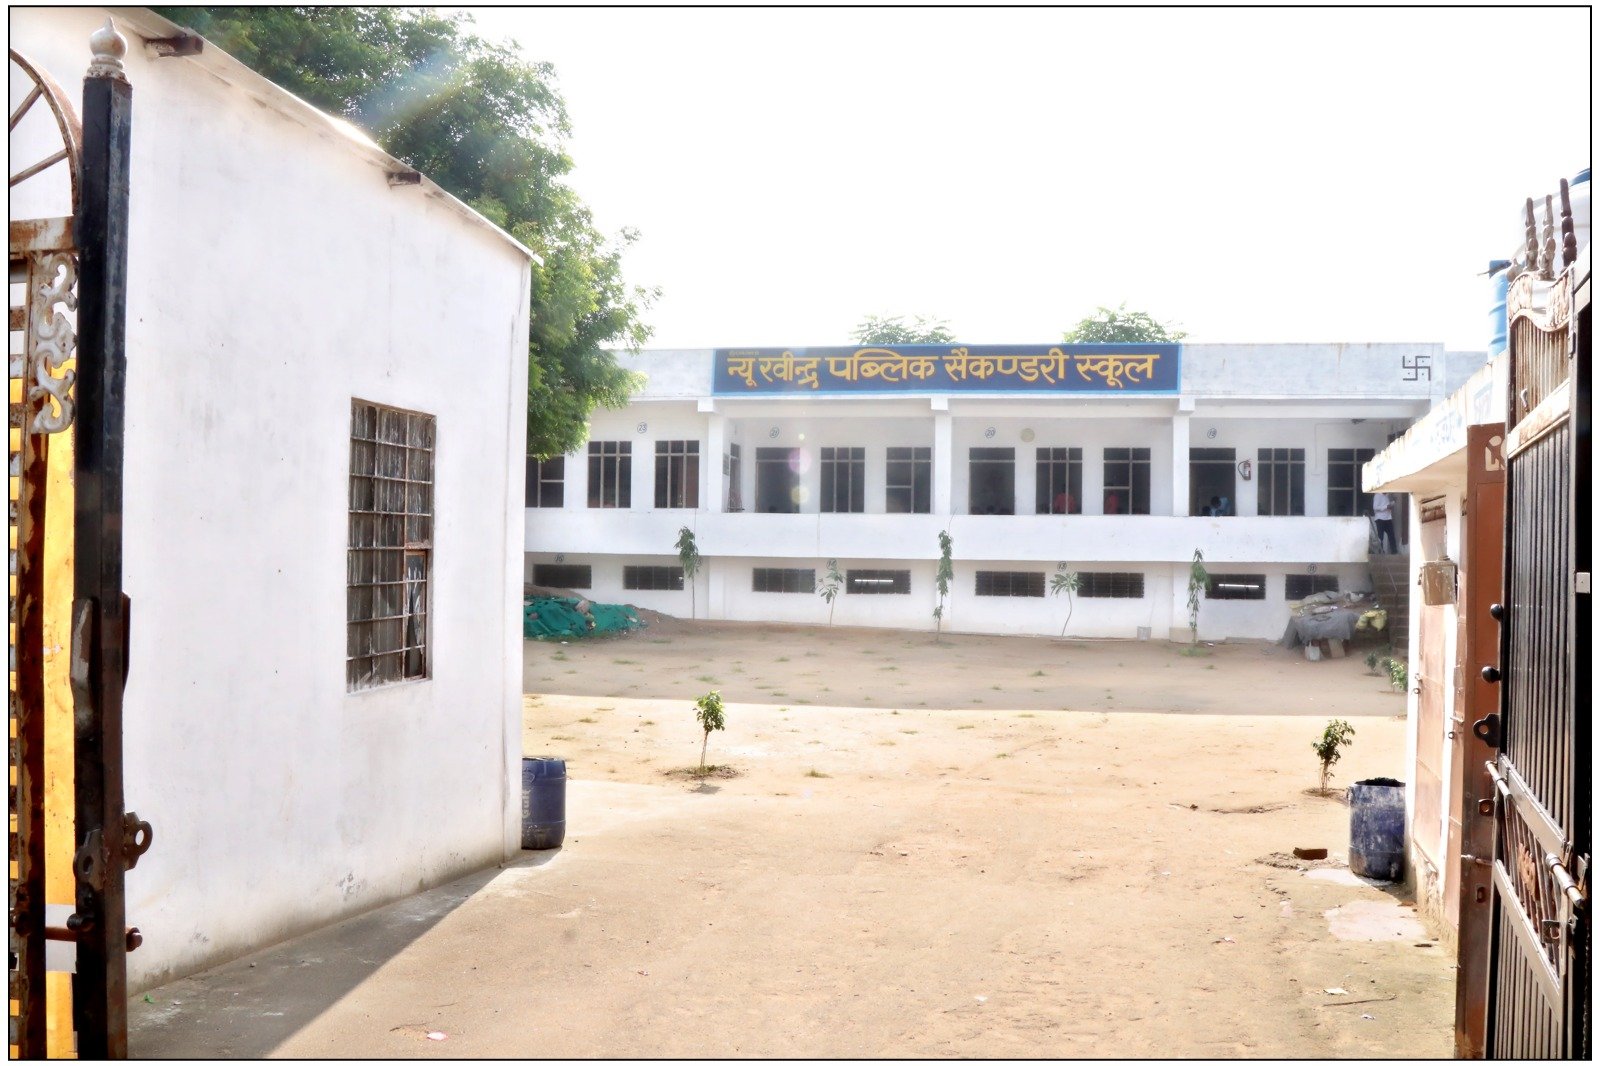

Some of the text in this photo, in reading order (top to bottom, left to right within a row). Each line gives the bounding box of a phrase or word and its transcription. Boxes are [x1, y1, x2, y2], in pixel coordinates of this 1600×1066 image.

[727, 347, 1160, 389] न्यू रवीन्द्र पब्लिक सैकण्डरी स्कूल
